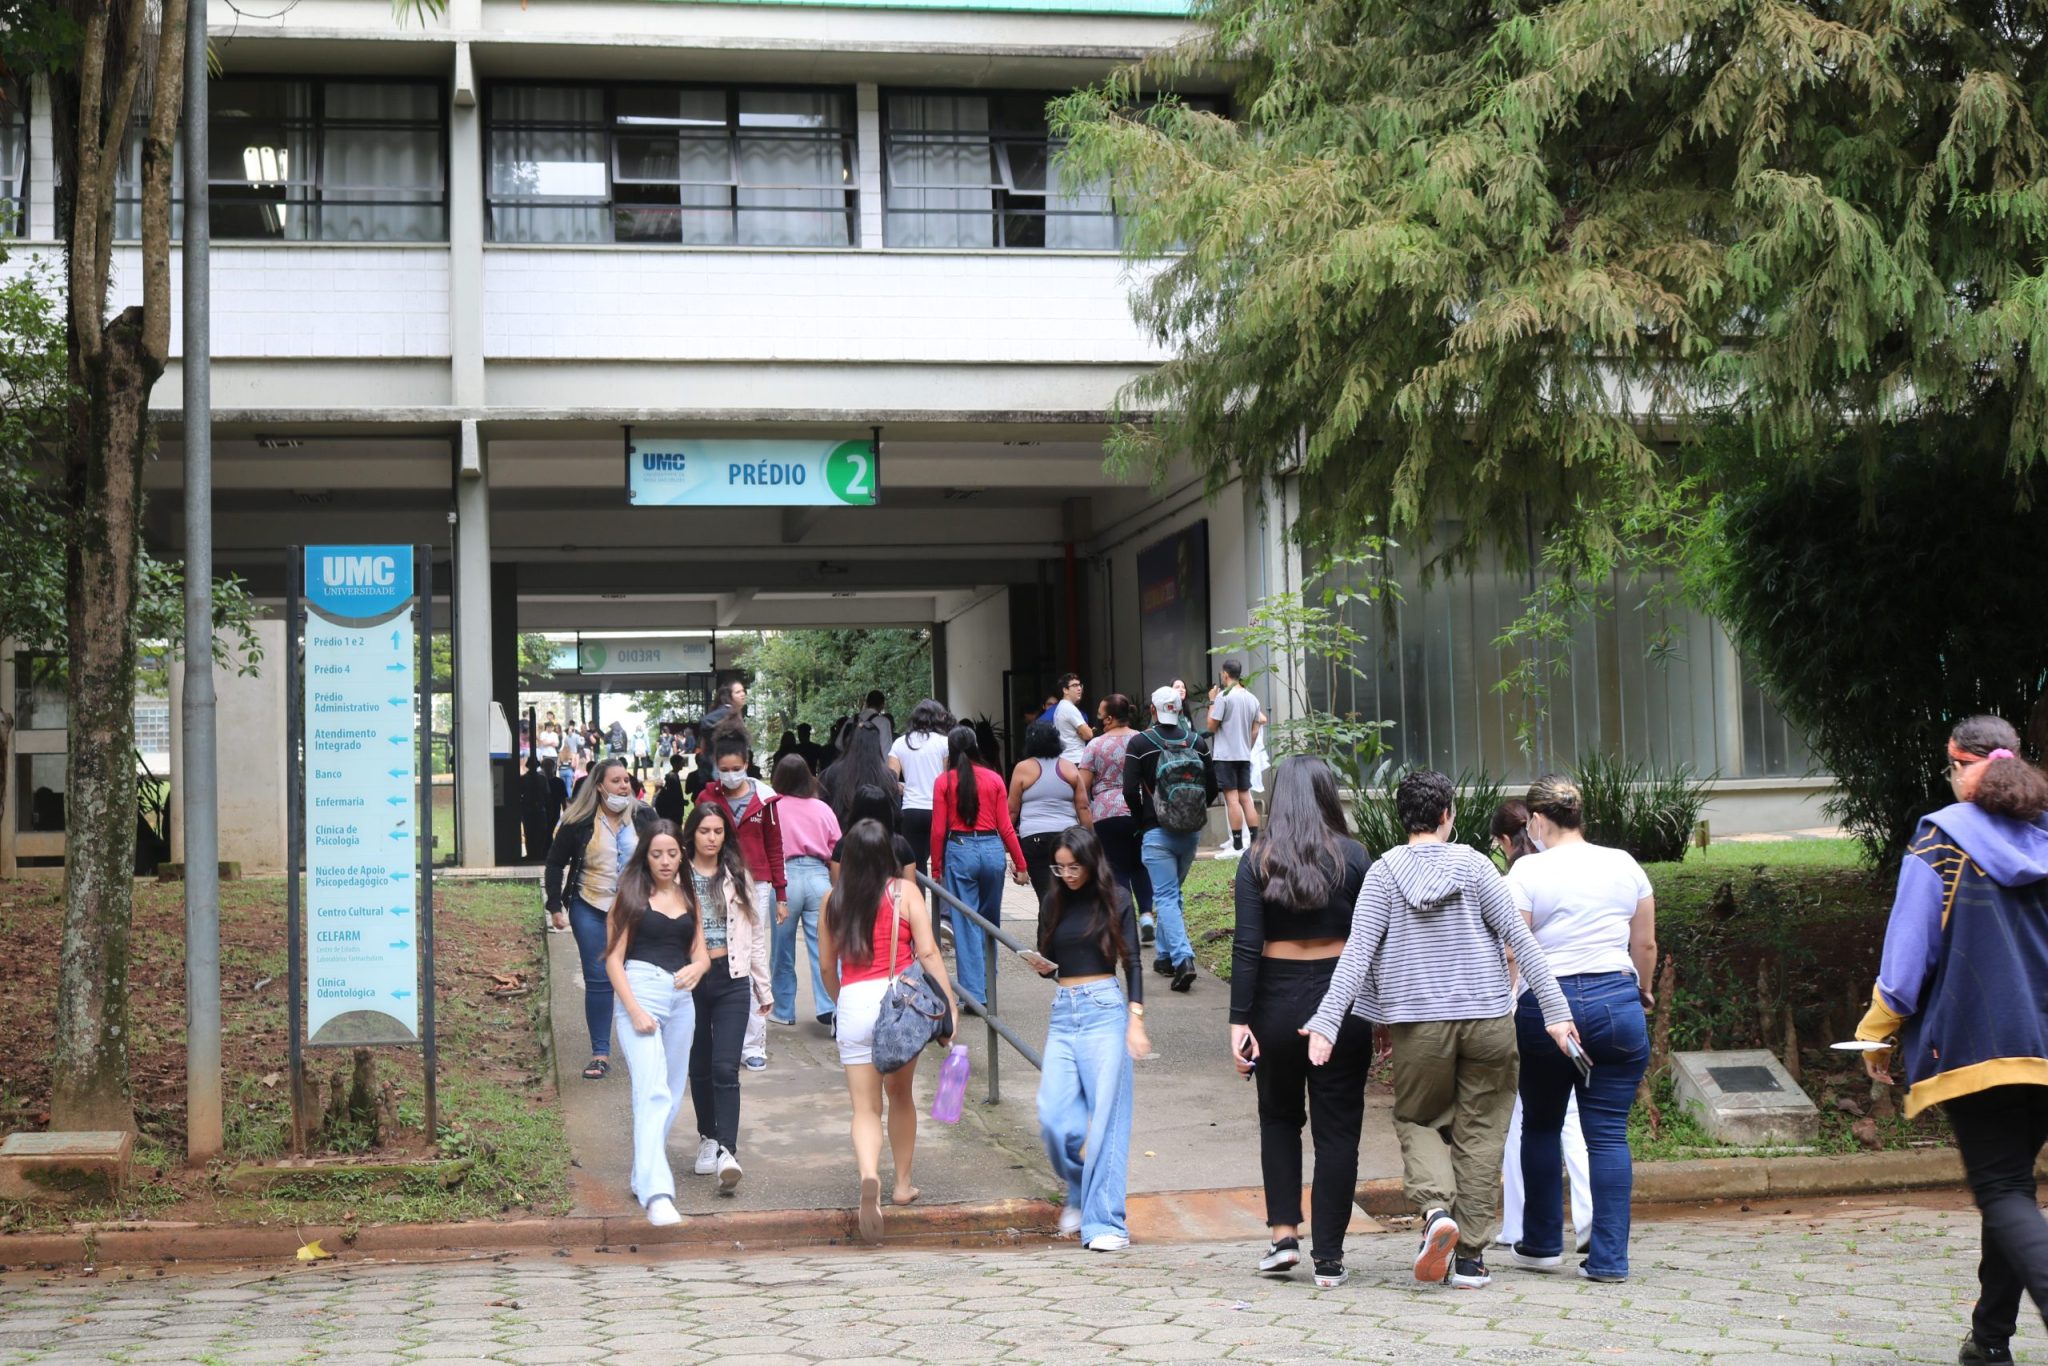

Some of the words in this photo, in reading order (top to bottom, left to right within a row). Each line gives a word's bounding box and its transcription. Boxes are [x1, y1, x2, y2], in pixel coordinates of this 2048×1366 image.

[642, 453, 686, 470] UMC
[729, 459, 806, 485] PRÉDIO
[846, 454, 868, 495] 2
[323, 556, 395, 586] UMC
[324, 587, 395, 596] UNIVERSIDADE
[314, 637, 343, 646] Prédio
[345, 637, 349, 646] 1
[359, 637, 364, 646] 2
[314, 664, 343, 674] Prédio
[345, 665, 350, 673] 4
[315, 692, 343, 702] Prédio
[315, 703, 379, 712] Administrativo
[315, 729, 376, 738] Atendimento
[315, 740, 362, 752] Integrado
[315, 770, 342, 779] Banco
[315, 797, 365, 807] Enfermaria
[315, 825, 344, 834] Clínica
[346, 825, 357, 834] de
[316, 836, 360, 847] Psicologia
[316, 866, 345, 876] Núcleo
[347, 866, 358, 875] de
[360, 865, 385, 877] Apoio
[316, 876, 388, 888] Psicopedagógico
[317, 907, 347, 917] Centro
[349, 906, 383, 916] Cultural
[317, 931, 360, 942] CELFARM
[317, 977, 346, 987] Clínica
[317, 988, 375, 999] Odontológica
